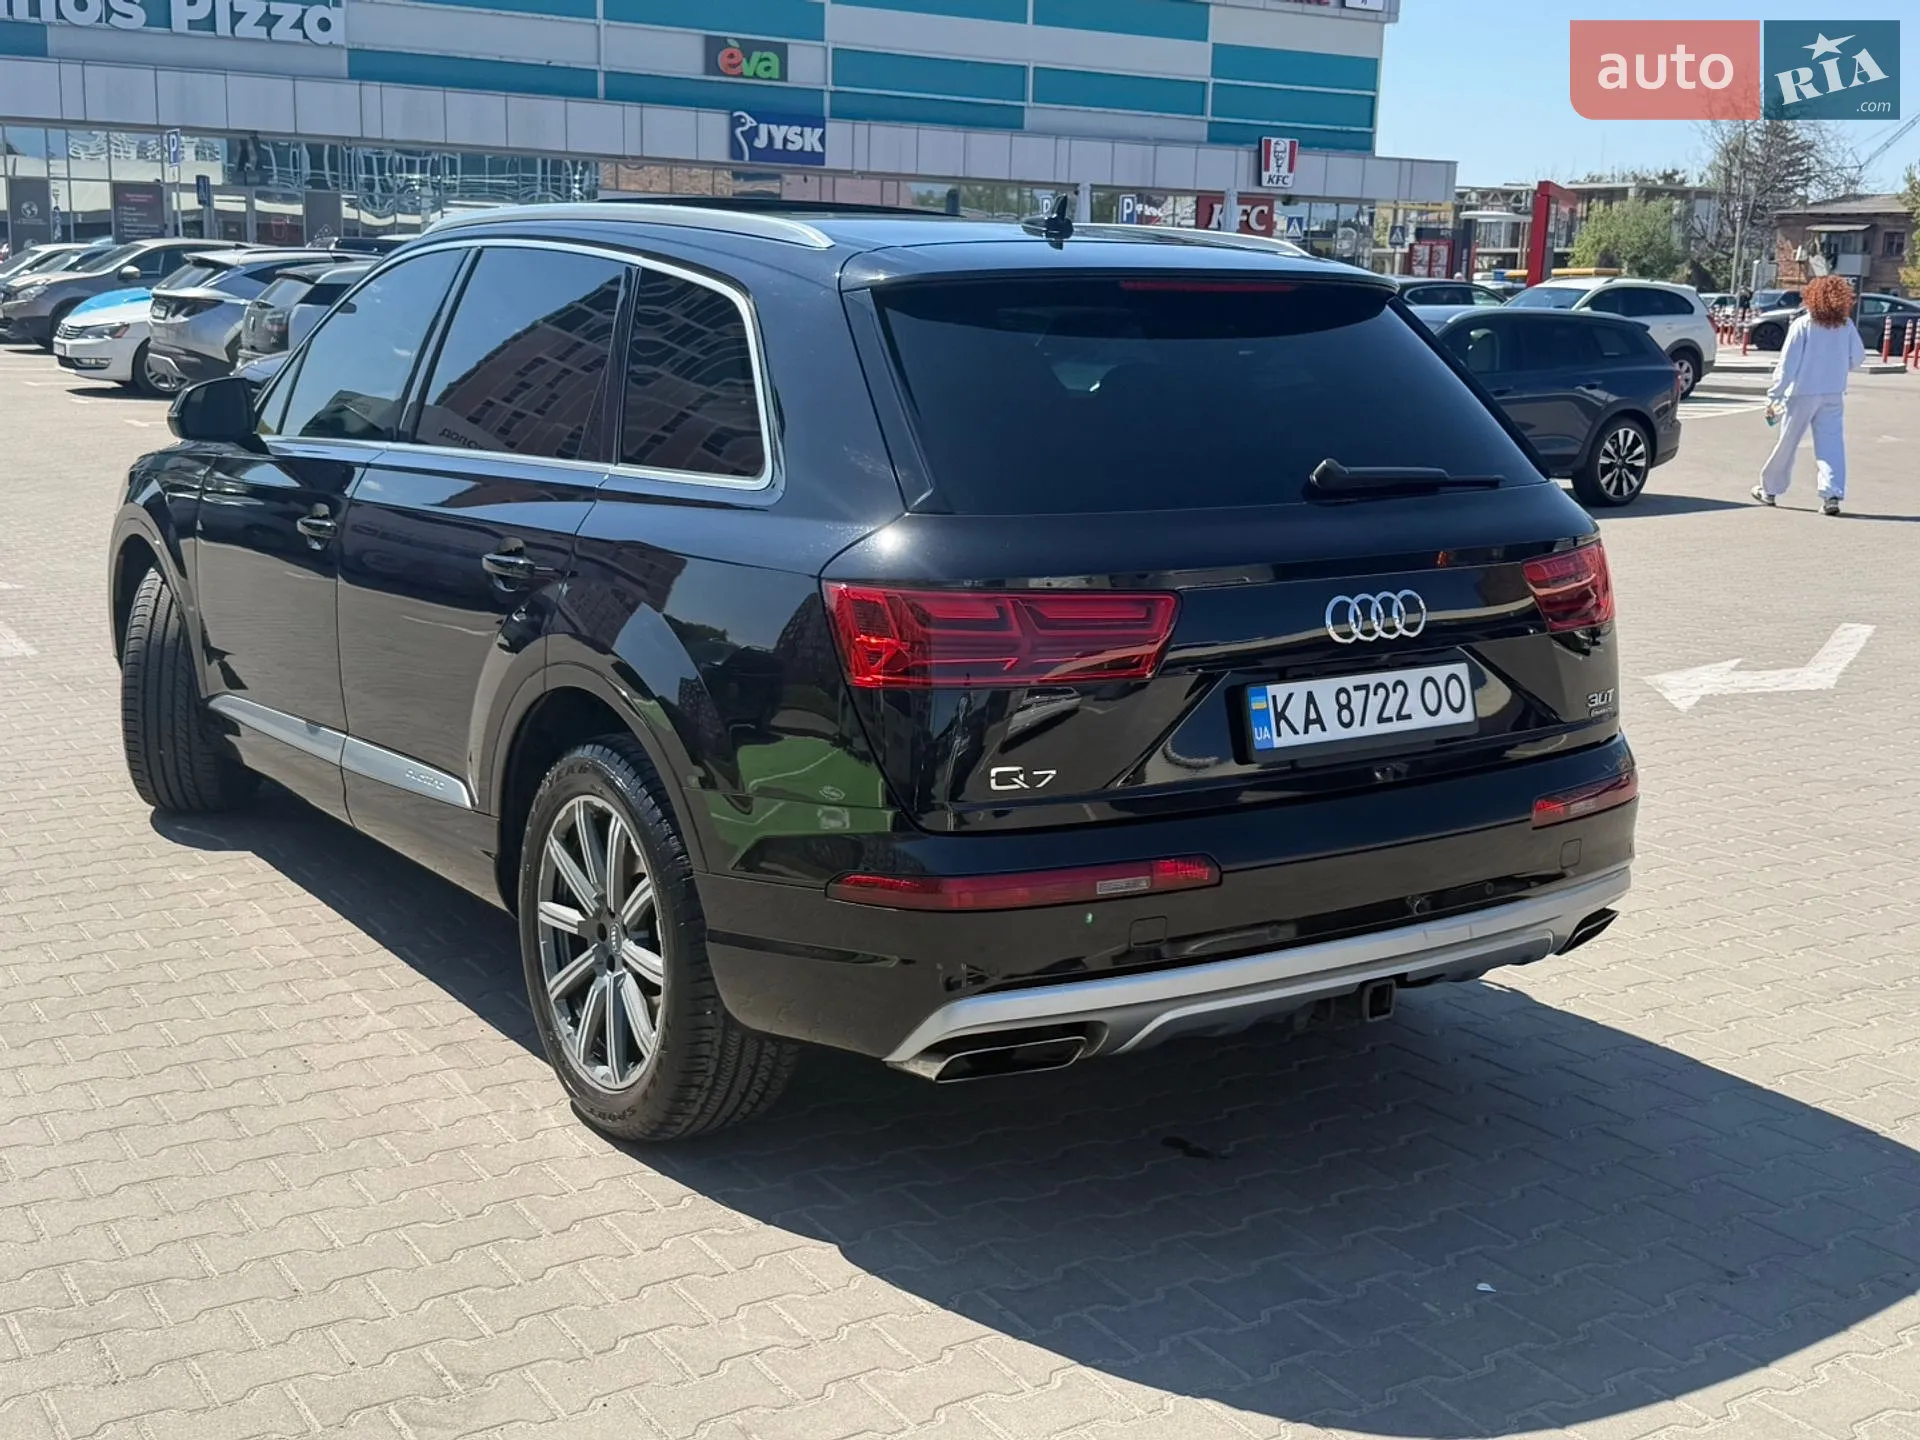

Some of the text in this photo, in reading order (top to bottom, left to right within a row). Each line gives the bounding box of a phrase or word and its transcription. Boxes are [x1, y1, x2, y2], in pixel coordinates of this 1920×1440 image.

[171, 0, 346, 45] Pizza
[753, 123, 824, 153] JYSK
[1266, 174, 1290, 186] KFC
[1271, 690, 1328, 738] KA
[1334, 679, 1413, 729] 8722
[1254, 726, 1271, 741] UA
[990, 766, 1057, 791] Q7
